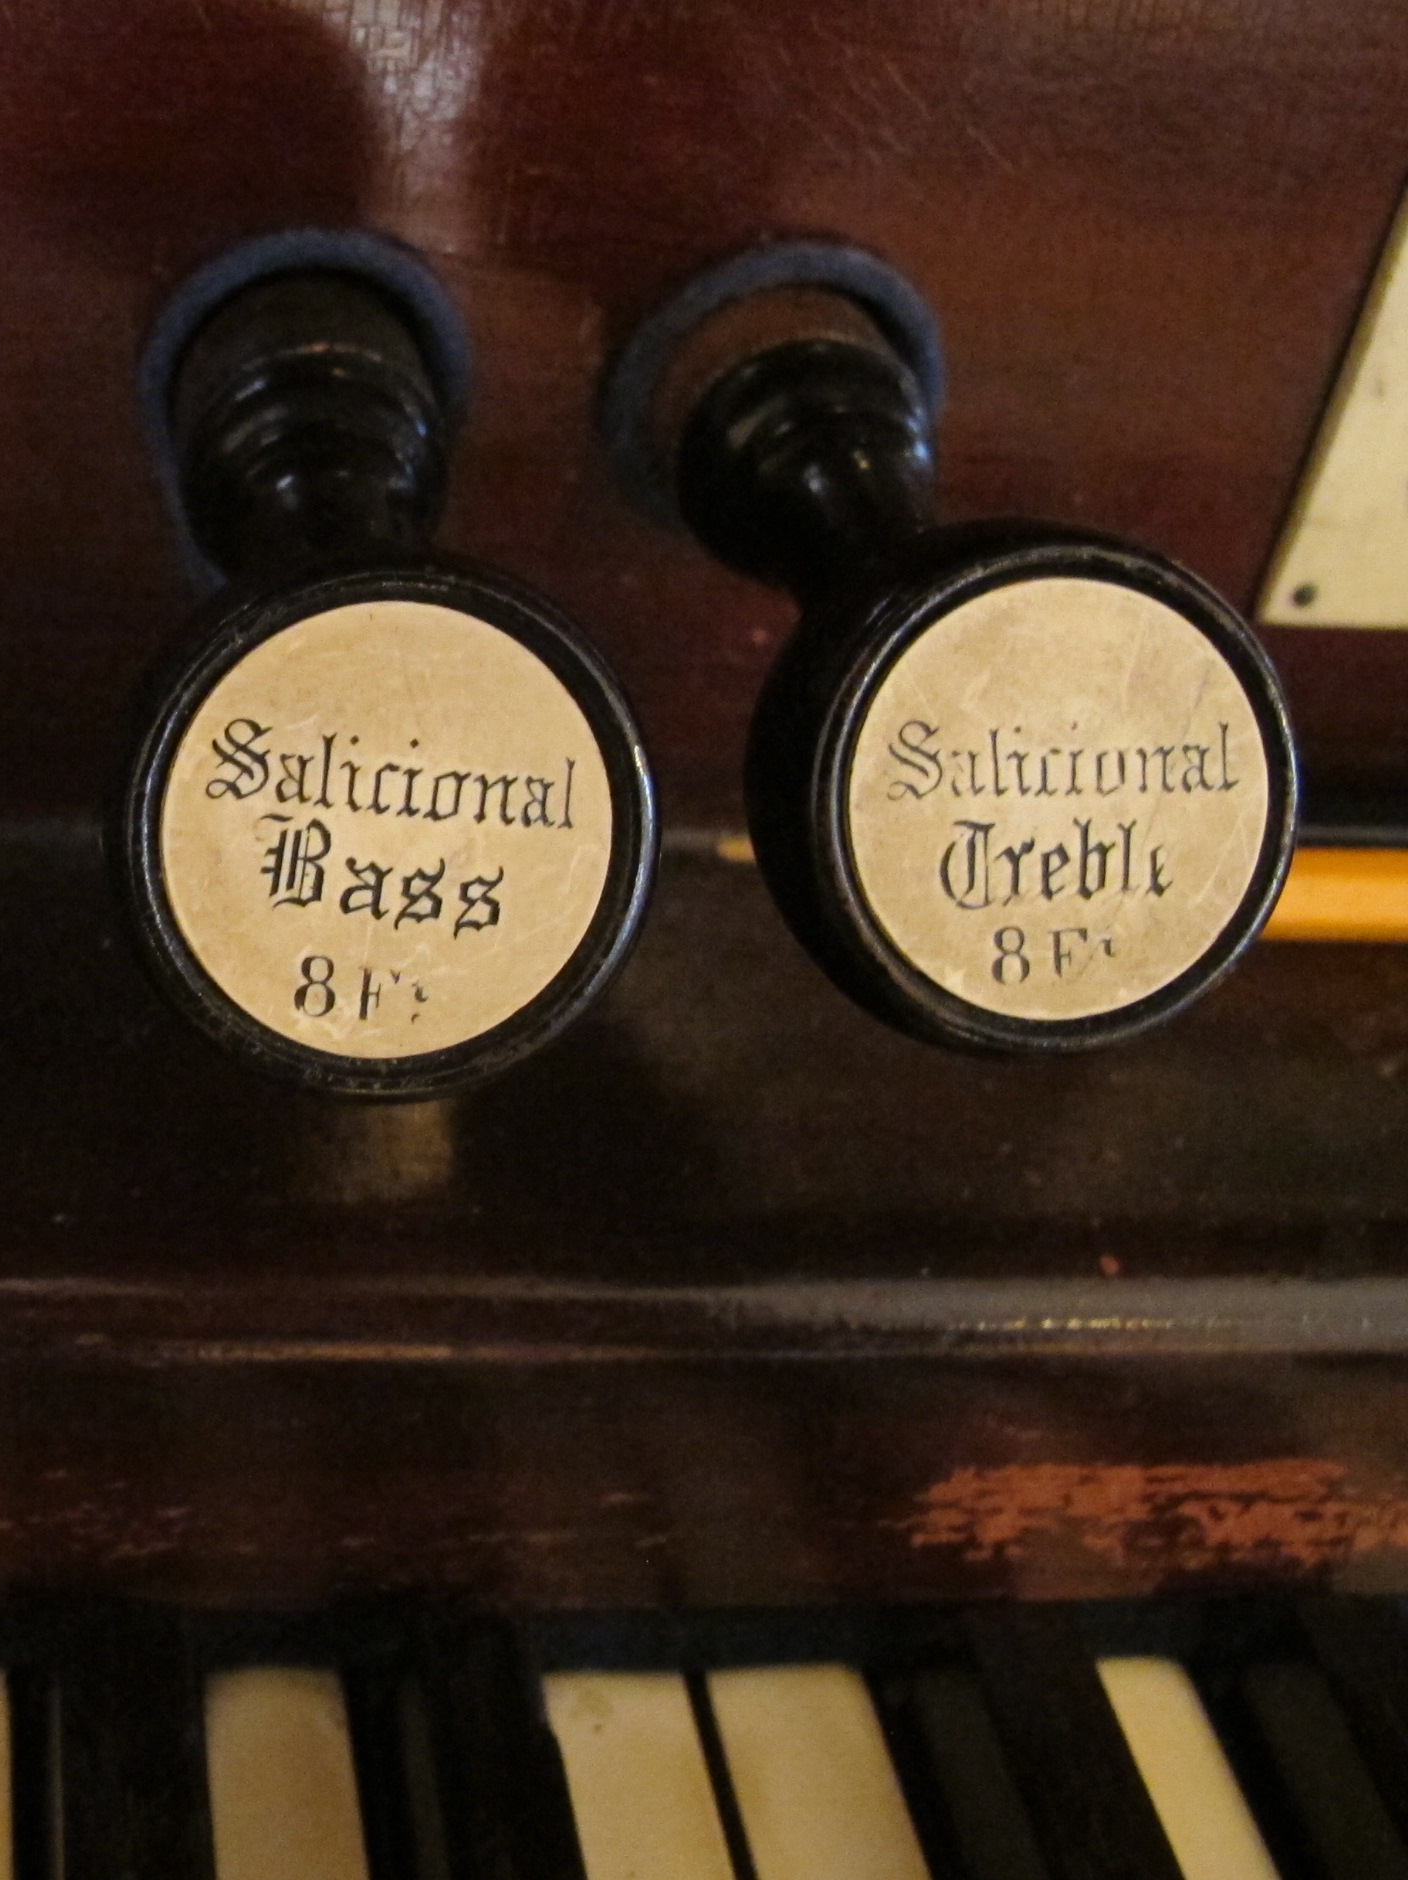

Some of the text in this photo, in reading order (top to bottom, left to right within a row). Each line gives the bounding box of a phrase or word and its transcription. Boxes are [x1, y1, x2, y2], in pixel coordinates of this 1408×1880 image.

[205, 718, 576, 829] Salicional
[887, 719, 1241, 801] Salicional
[259, 813, 504, 939] Bass
[294, 955, 336, 1018] 8
[991, 926, 1031, 985] 8
